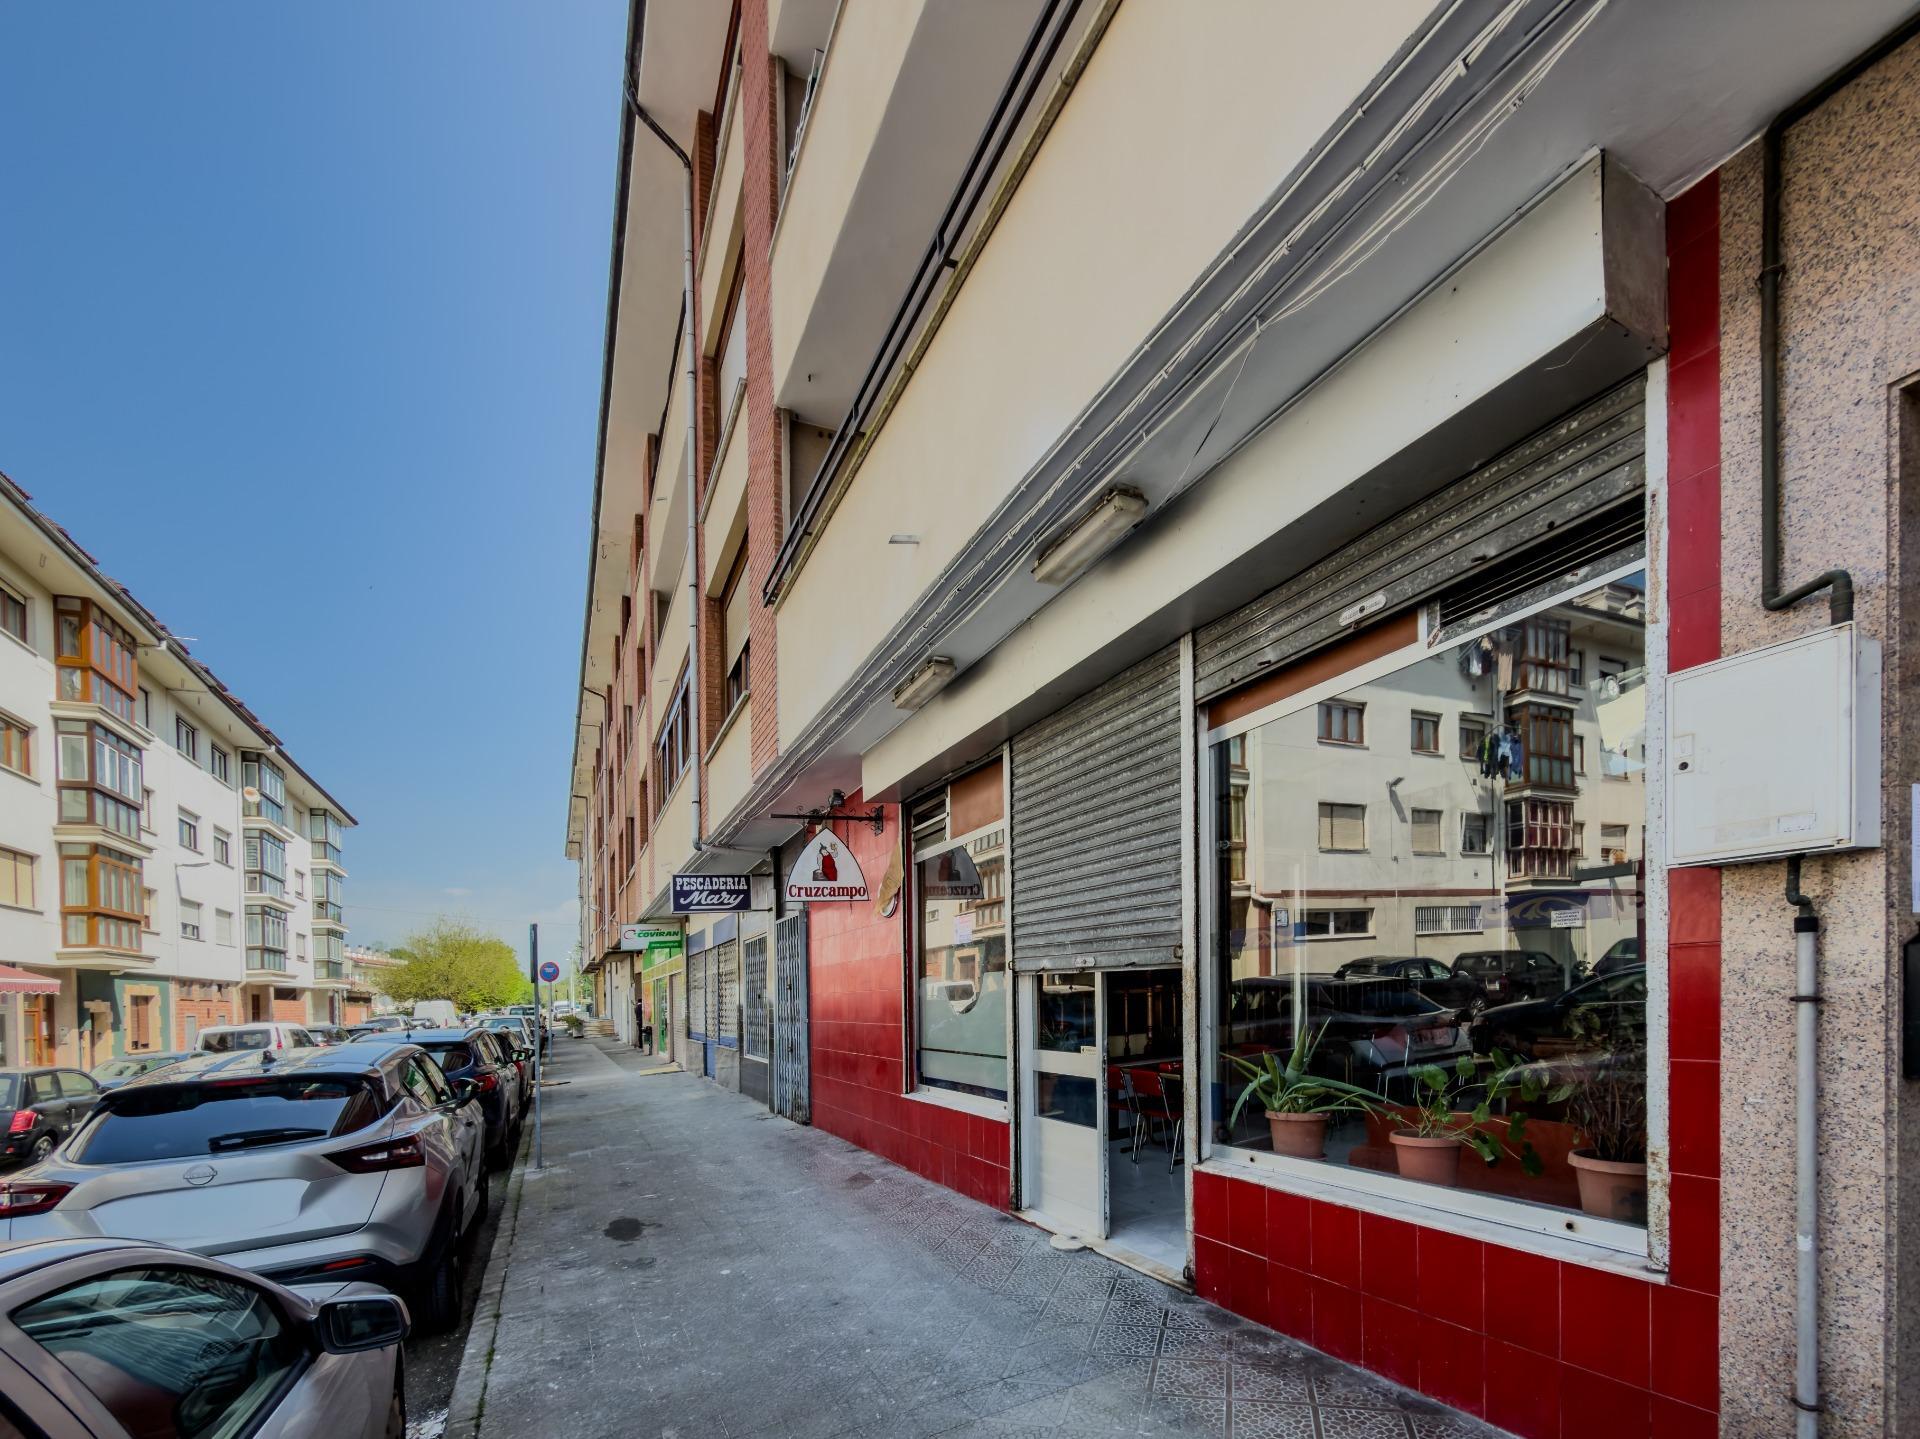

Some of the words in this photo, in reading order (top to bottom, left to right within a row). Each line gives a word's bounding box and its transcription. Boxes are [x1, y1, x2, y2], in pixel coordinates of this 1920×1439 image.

[675, 877, 748, 891] PESCADERIA
[788, 884, 867, 899] Cruzcampo
[680, 890, 744, 909] Mary
